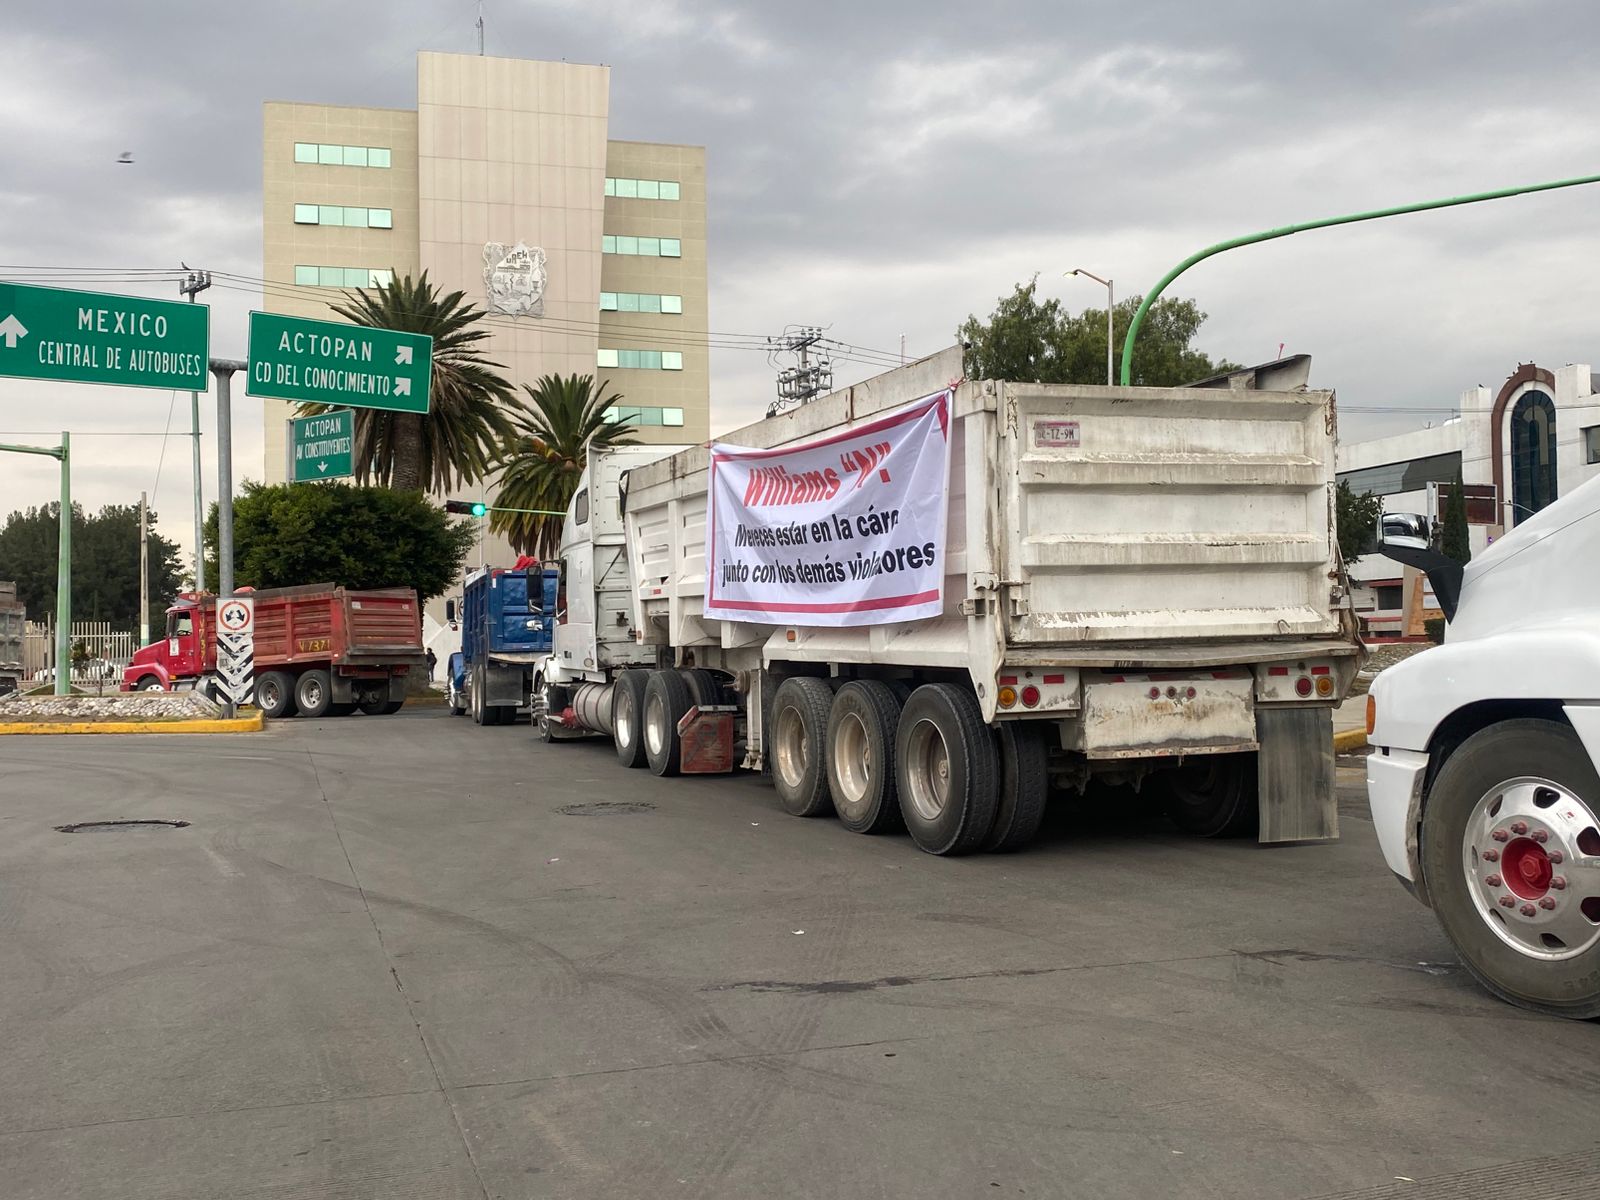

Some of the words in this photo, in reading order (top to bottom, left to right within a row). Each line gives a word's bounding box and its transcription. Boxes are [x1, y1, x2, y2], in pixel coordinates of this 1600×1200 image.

[78, 307, 168, 339] MEXICO
[38, 340, 99, 369] CENTRAL
[106, 345, 122, 371] DE
[129, 348, 201, 376] AUTOBUSES
[278, 330, 373, 362] ACTOPAN
[255, 361, 272, 384] CD
[276, 362, 300, 386] DEL
[304, 366, 391, 397] CONOCIMIENTO
[304, 417, 341, 438] ACTOPAN
[296, 444, 304, 460] AV
[305, 437, 351, 459] CONSTITUYENTES
[743, 465, 841, 508] Williams
[776, 521, 809, 546] estar
[811, 523, 833, 544] en
[832, 513, 854, 540] la
[722, 559, 749, 587] junto
[752, 564, 777, 585] con
[777, 560, 796, 584] los
[796, 554, 846, 584] demás
